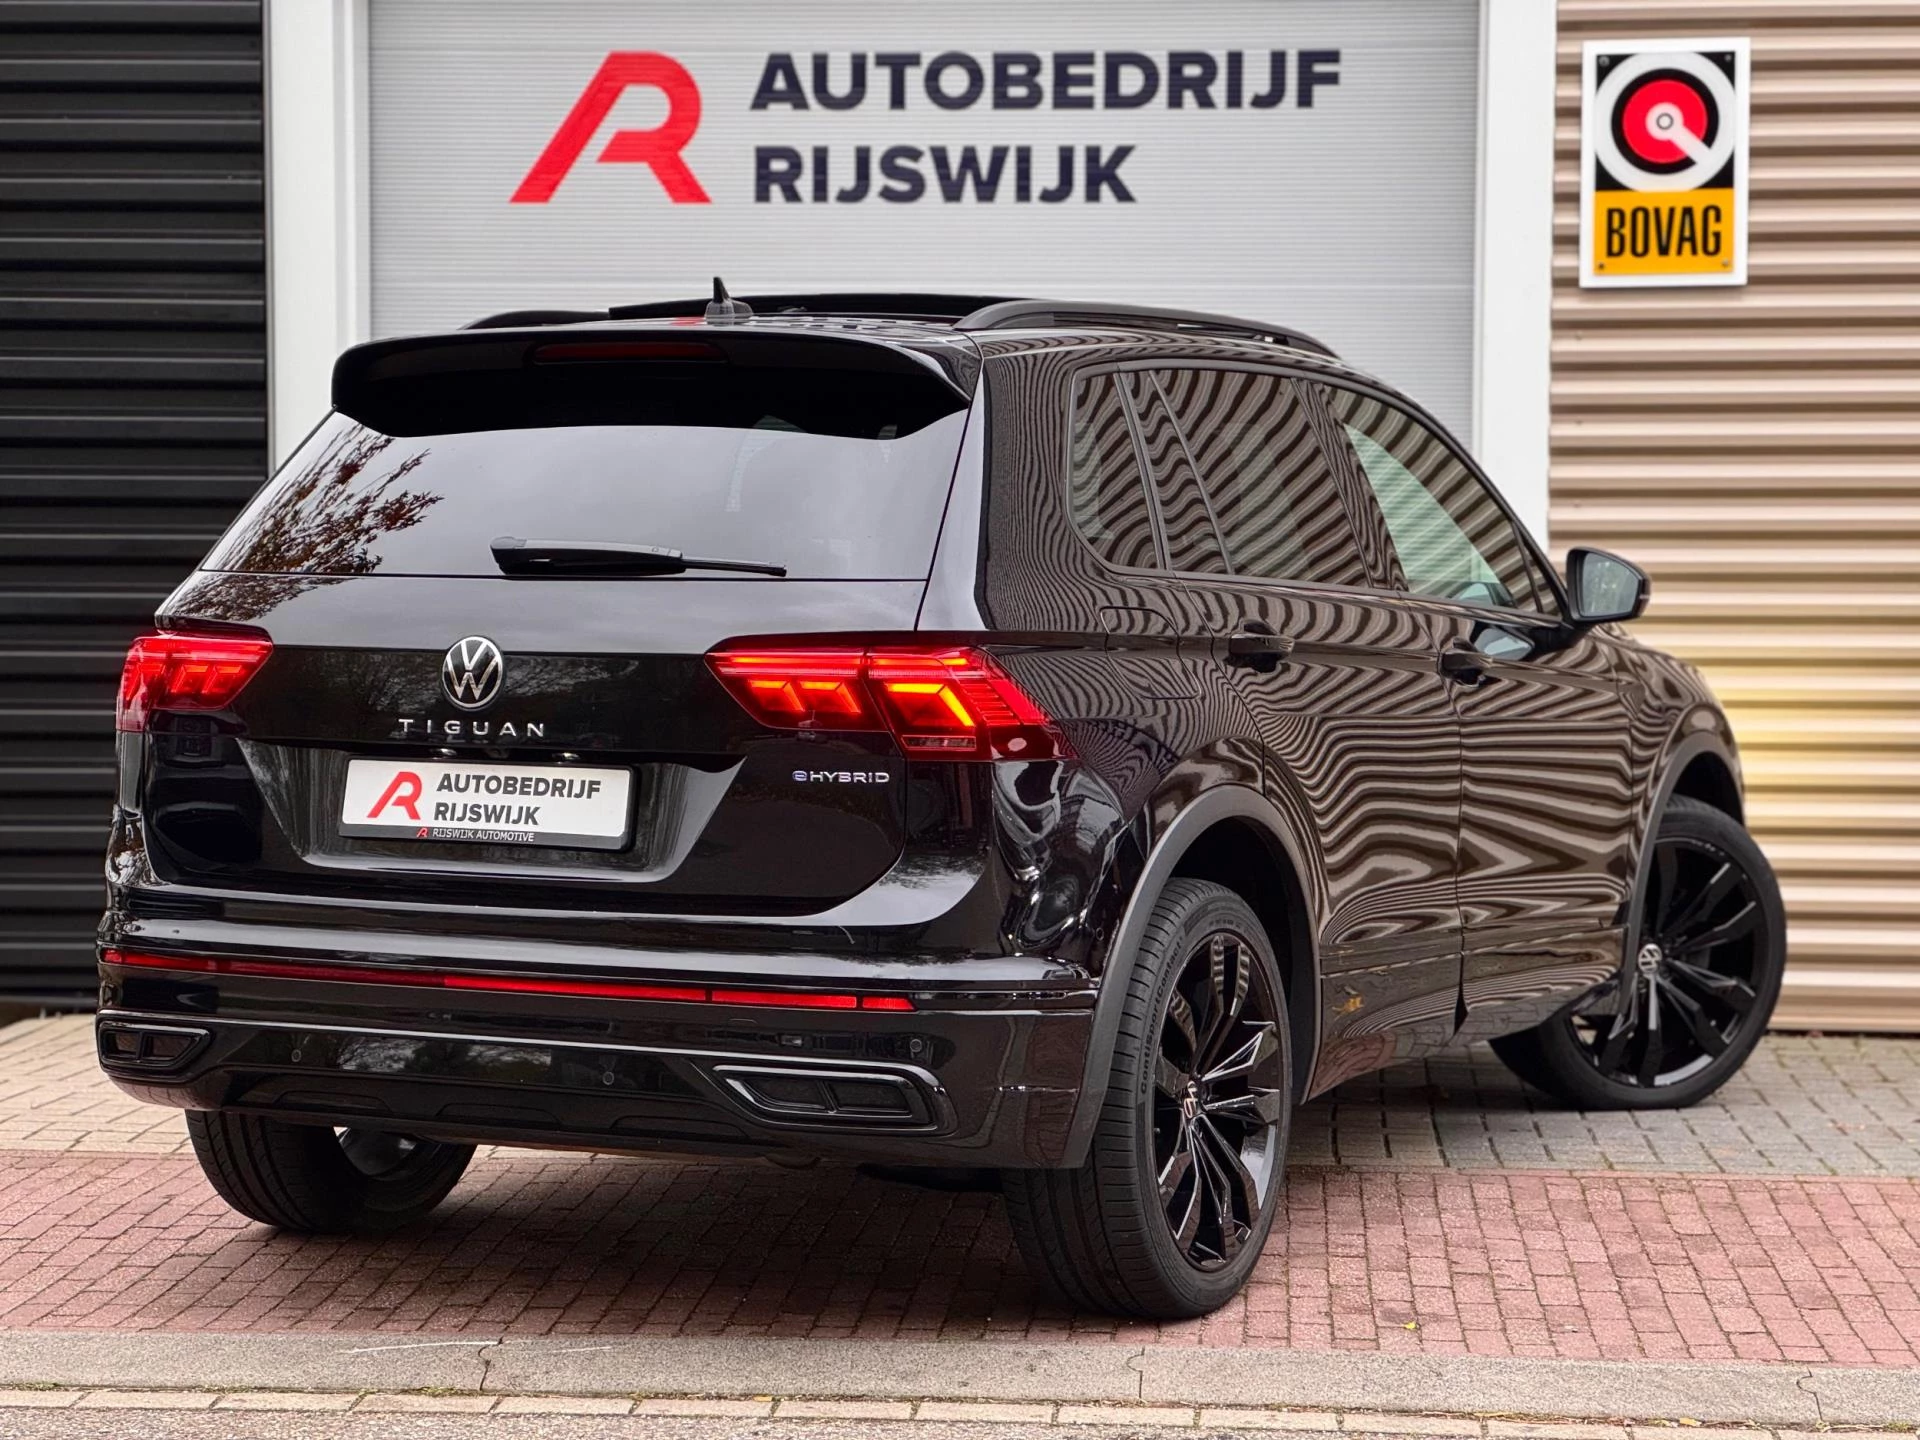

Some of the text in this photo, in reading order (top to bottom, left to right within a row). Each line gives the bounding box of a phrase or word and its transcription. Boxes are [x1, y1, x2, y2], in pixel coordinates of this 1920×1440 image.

[750, 49, 1341, 112] AUTOBEDRIJF
[754, 145, 1138, 204] RIJSWIJK
[1606, 205, 1722, 258] BOVAG
[398, 718, 545, 738] TIGUAN
[436, 773, 601, 800] AUTOBEDRIJF
[433, 802, 541, 826] RIJSWIJK
[432, 828, 535, 842] RIJSWIJK AUTOMOTIVE
